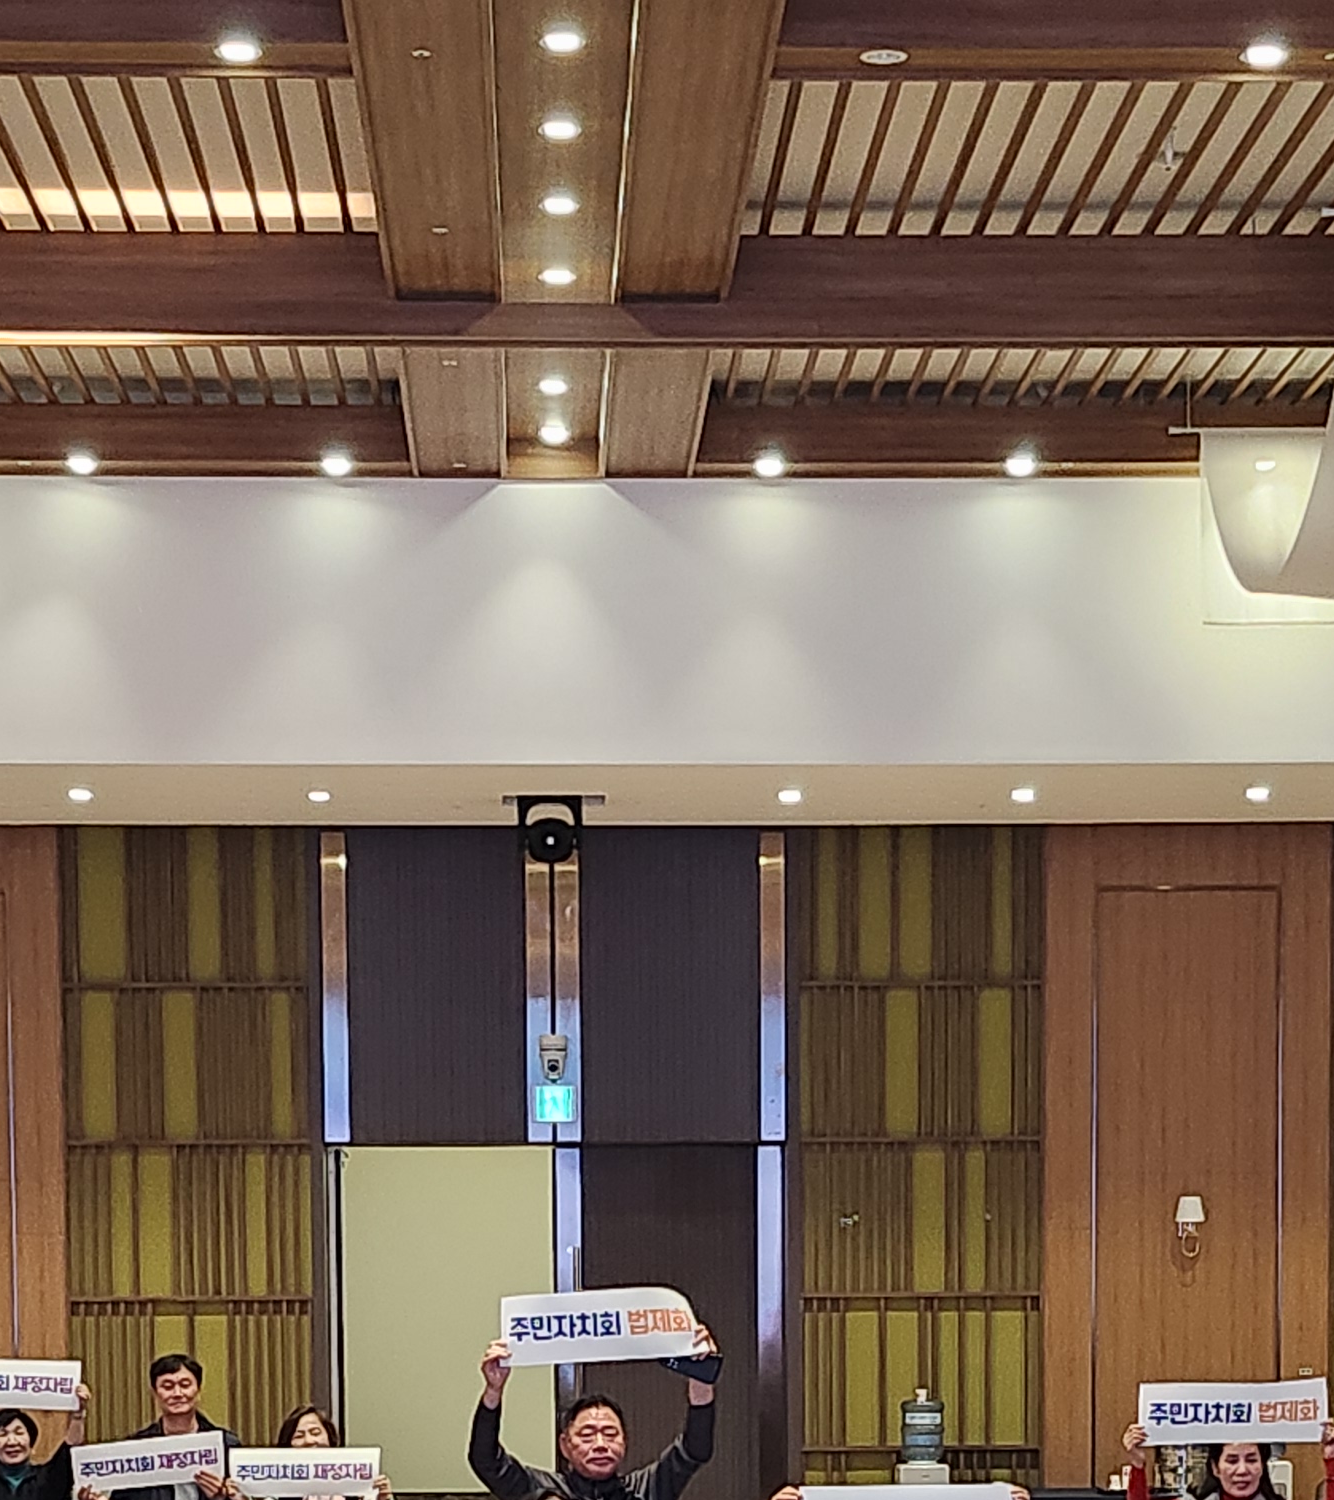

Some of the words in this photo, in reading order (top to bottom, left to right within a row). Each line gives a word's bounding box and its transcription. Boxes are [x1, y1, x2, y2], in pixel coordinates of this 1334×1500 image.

[509, 1311, 622, 1341] 주민자치회
[628, 1307, 692, 1335] 법제화
[12, 1375, 74, 1396] 재정자립
[1148, 1402, 1252, 1426] 주민자치회
[1258, 1400, 1319, 1424] 법제화
[80, 1455, 155, 1479] 주민자치회
[157, 1447, 218, 1472] 재정자립
[236, 1462, 309, 1482] 주민자치회
[313, 1462, 373, 1482] 재정자립
